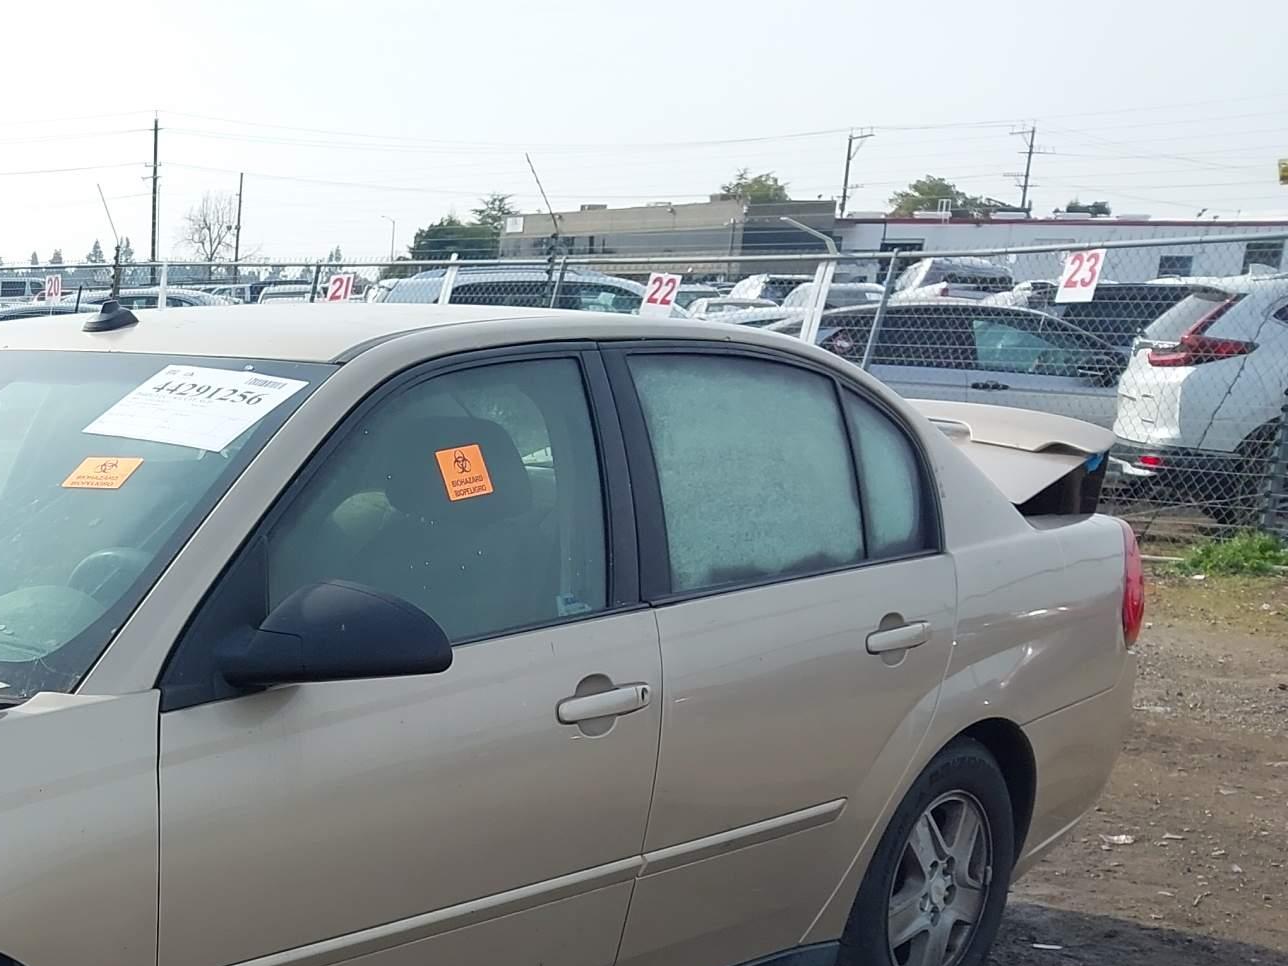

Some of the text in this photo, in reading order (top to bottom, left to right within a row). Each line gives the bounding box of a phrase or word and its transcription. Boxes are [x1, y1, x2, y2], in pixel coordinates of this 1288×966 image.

[1063, 252, 1100, 288] 23
[47, 276, 59, 296] 20
[328, 276, 351, 301] 21
[646, 276, 677, 305] 22
[152, 380, 270, 406] 44291256
[451, 474, 484, 488] BIOHAZARD
[453, 484, 487, 497] BIOPELIGRO
